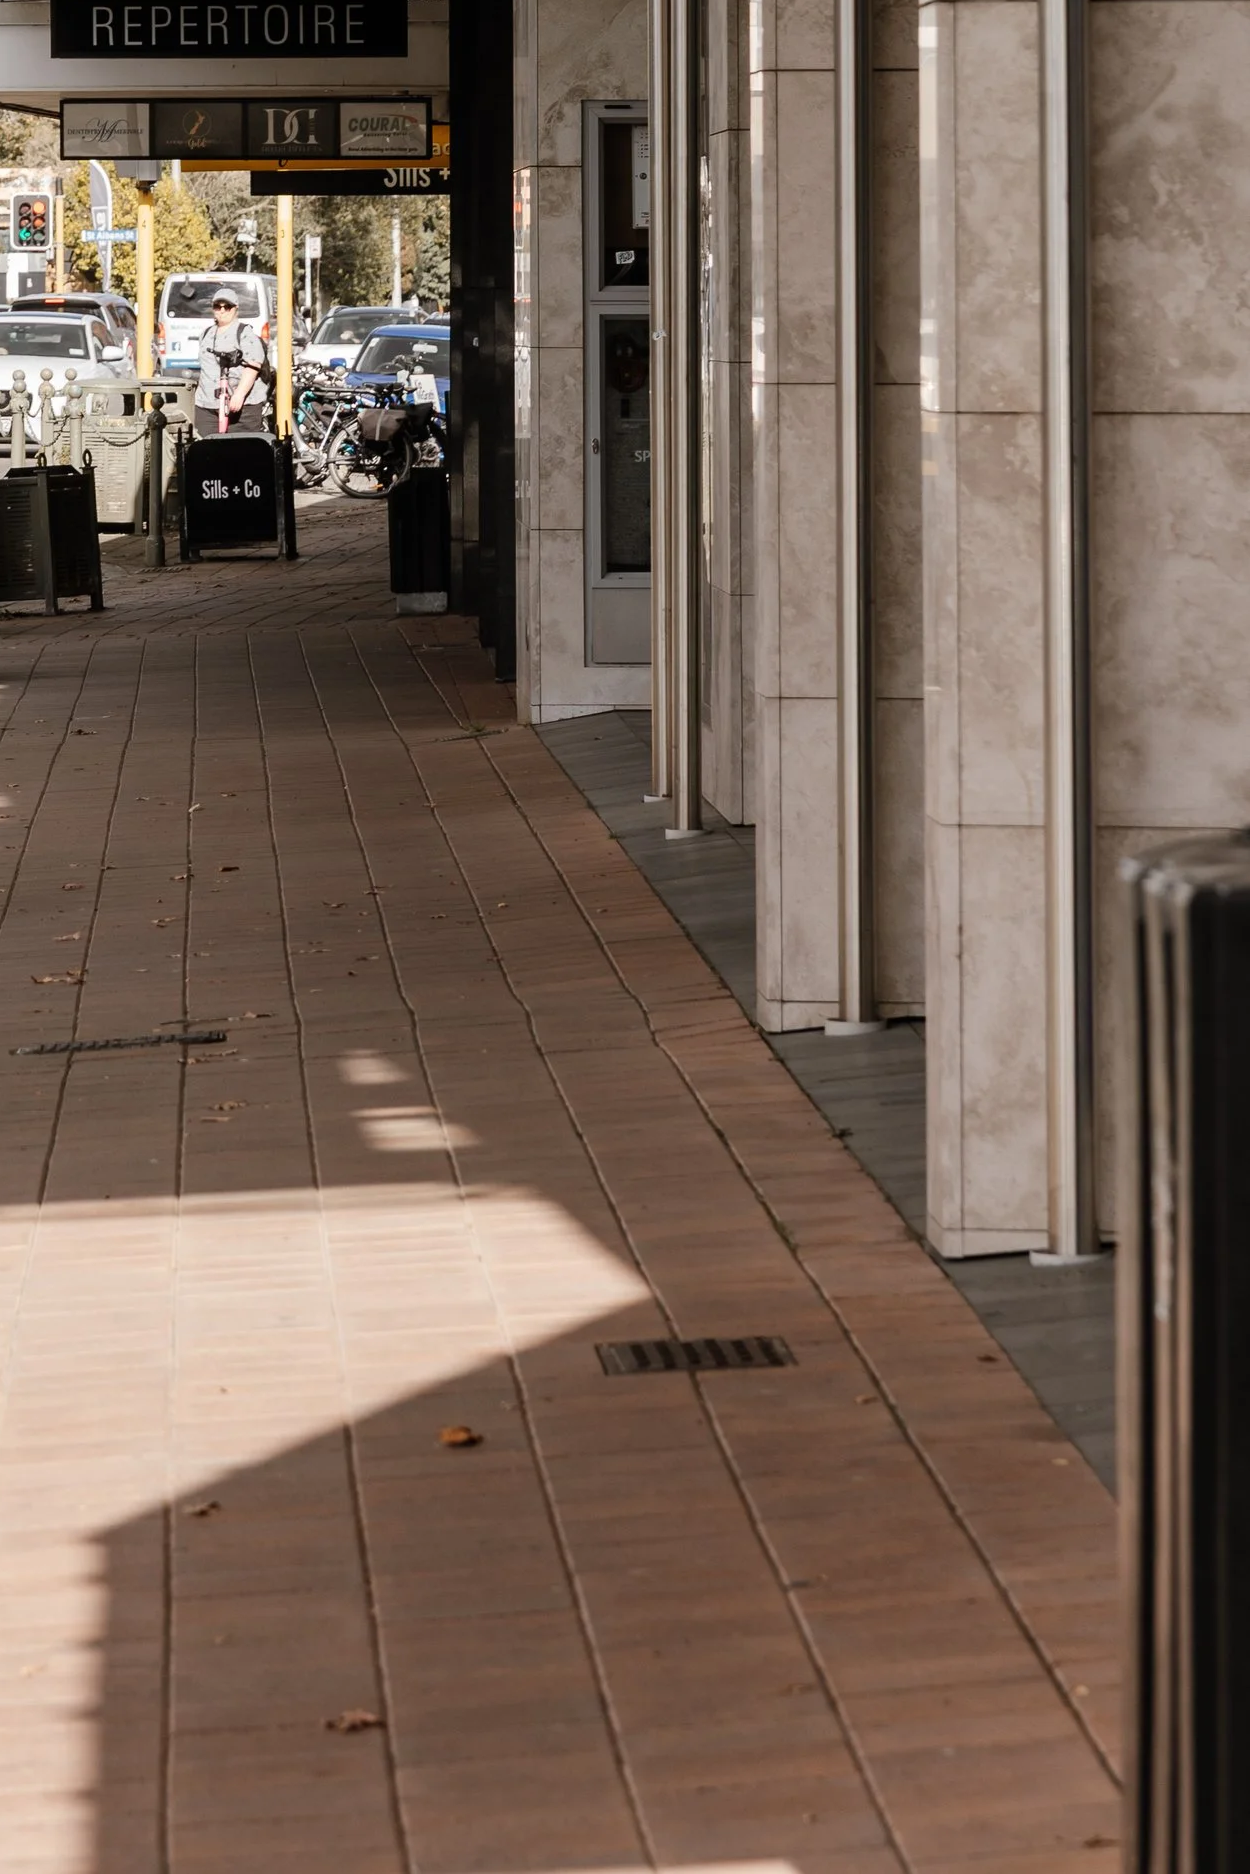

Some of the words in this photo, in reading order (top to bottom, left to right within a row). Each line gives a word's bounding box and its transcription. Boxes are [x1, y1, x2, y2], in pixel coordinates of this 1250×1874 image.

[92, 3, 365, 46] REPERTOIRE
[202, 479, 229, 500] Sills
[244, 478, 261, 499] Co
